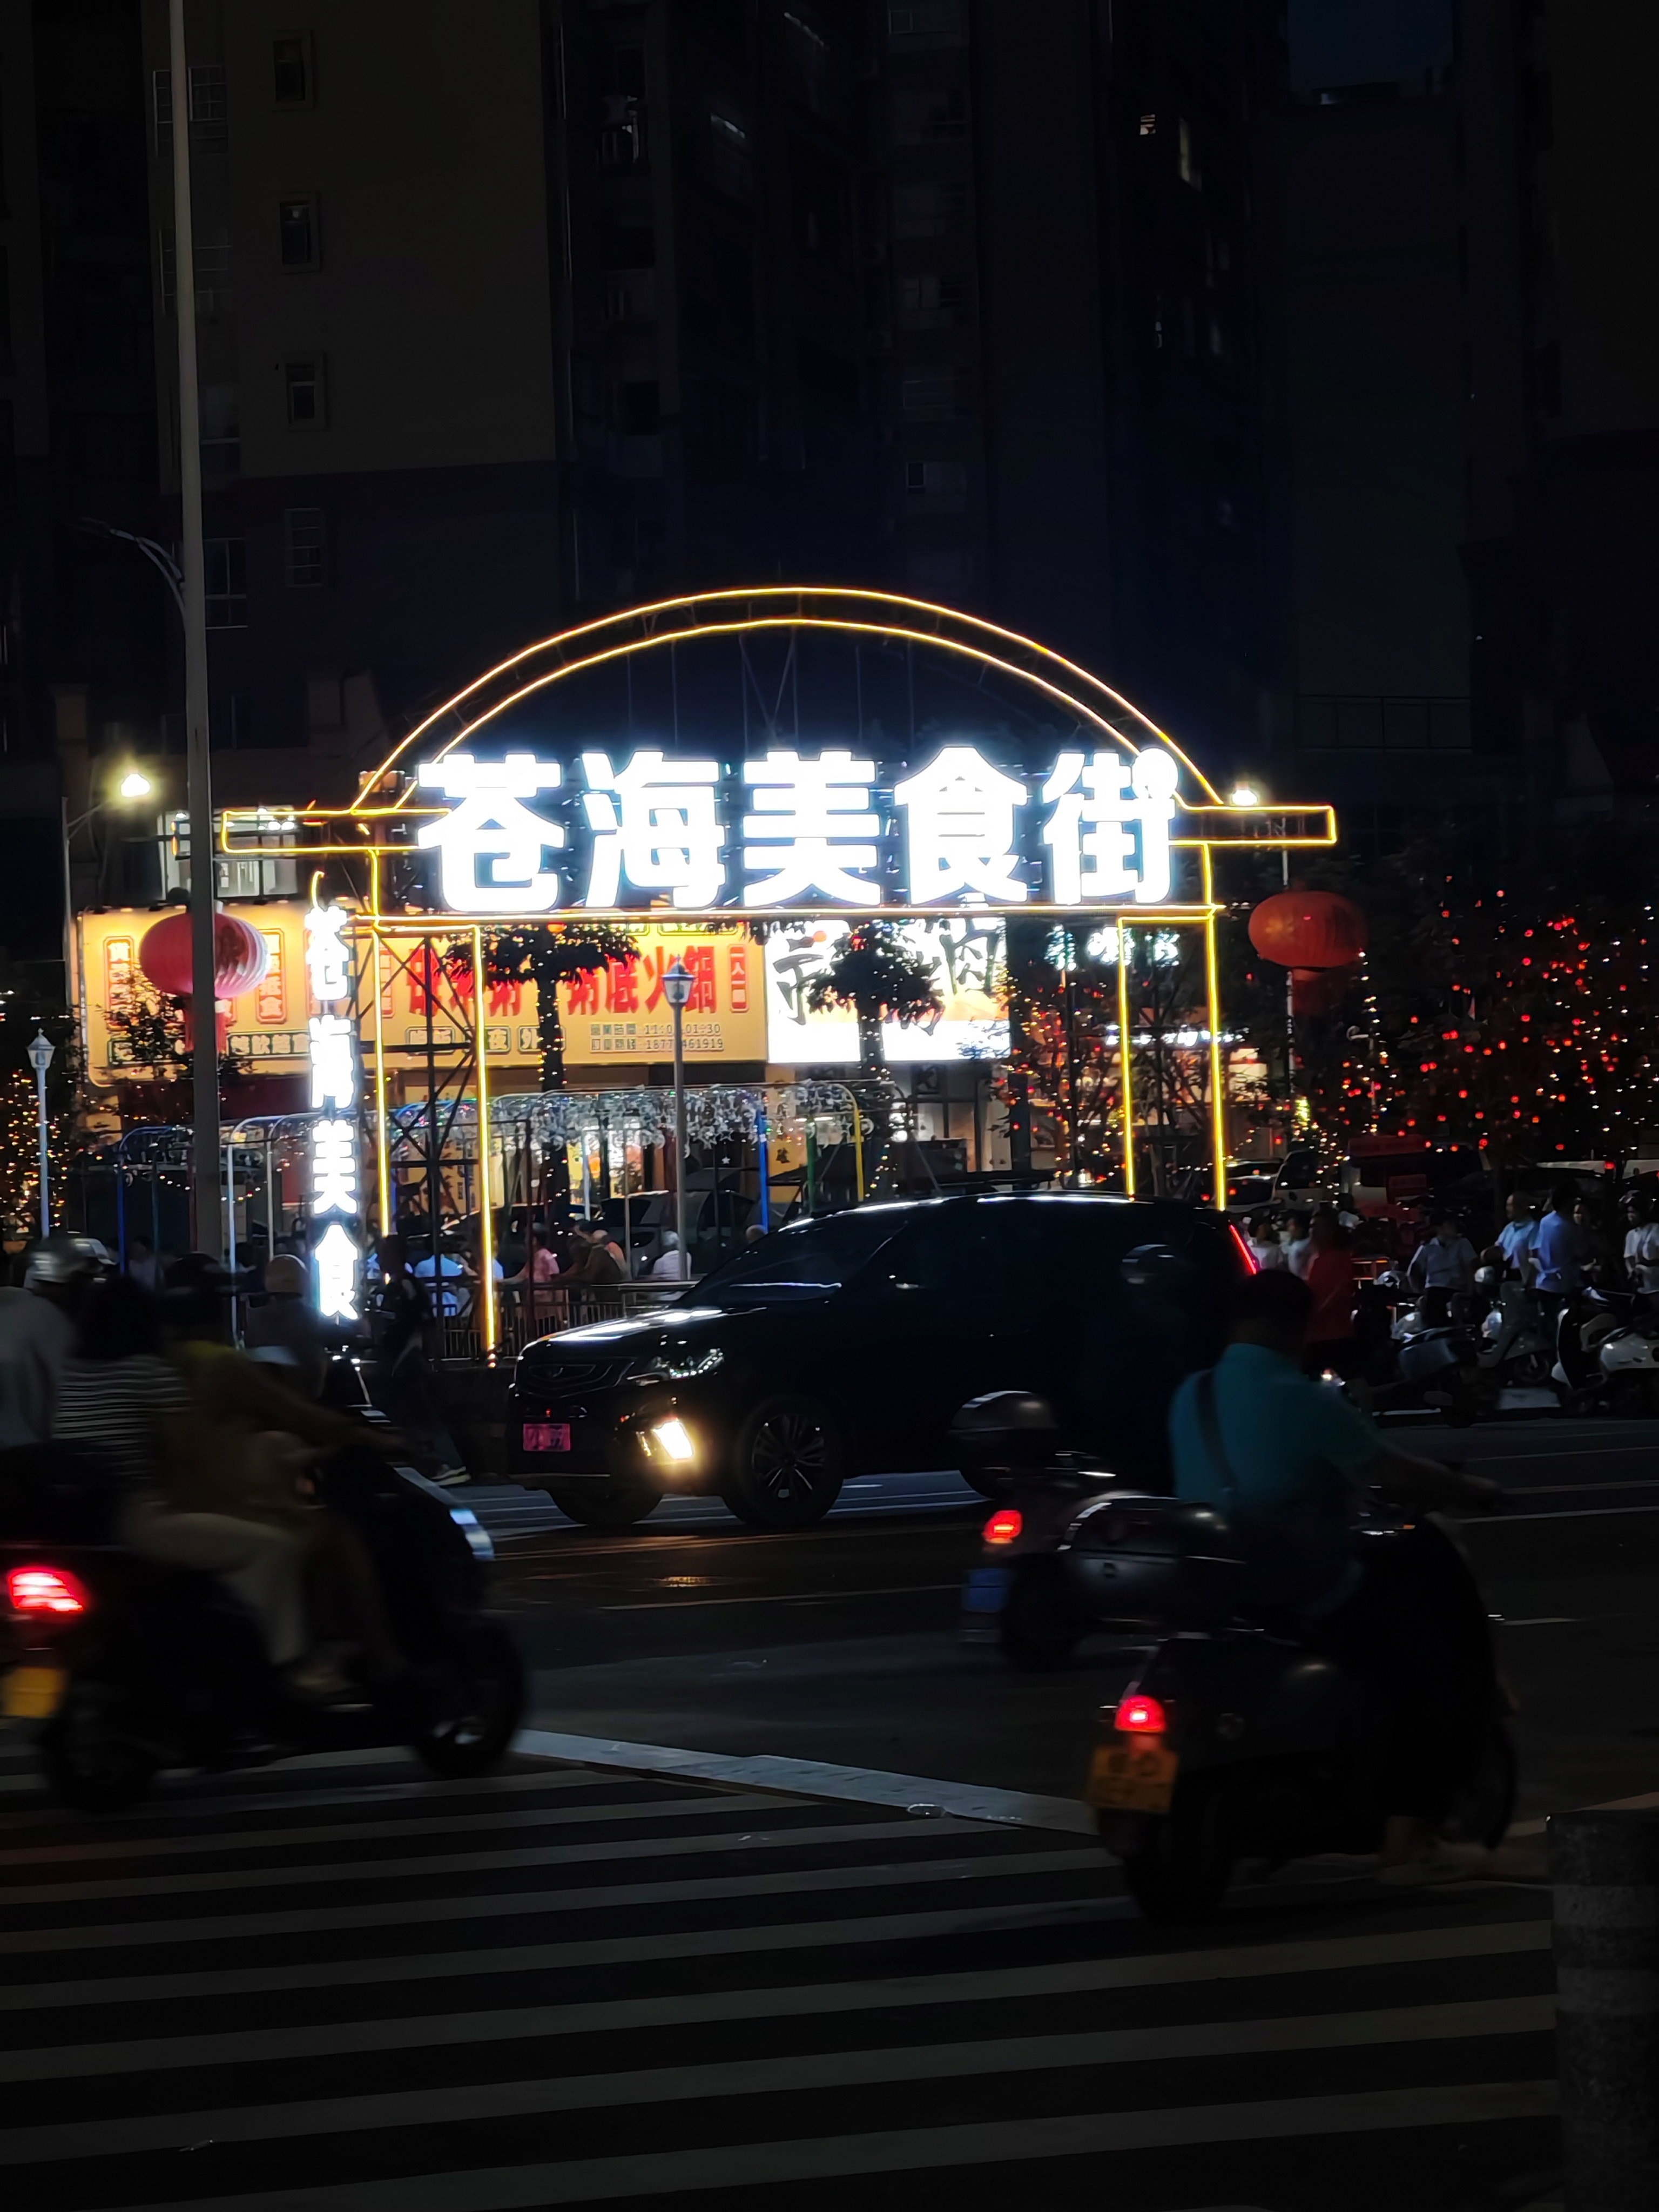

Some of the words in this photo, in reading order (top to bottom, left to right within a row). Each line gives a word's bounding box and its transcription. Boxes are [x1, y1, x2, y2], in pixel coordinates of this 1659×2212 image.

[418, 747, 1177, 913] 苍海美食街
[305, 906, 359, 1319] 苍海美食
[646, 1037, 723, 1049] 1877461919
